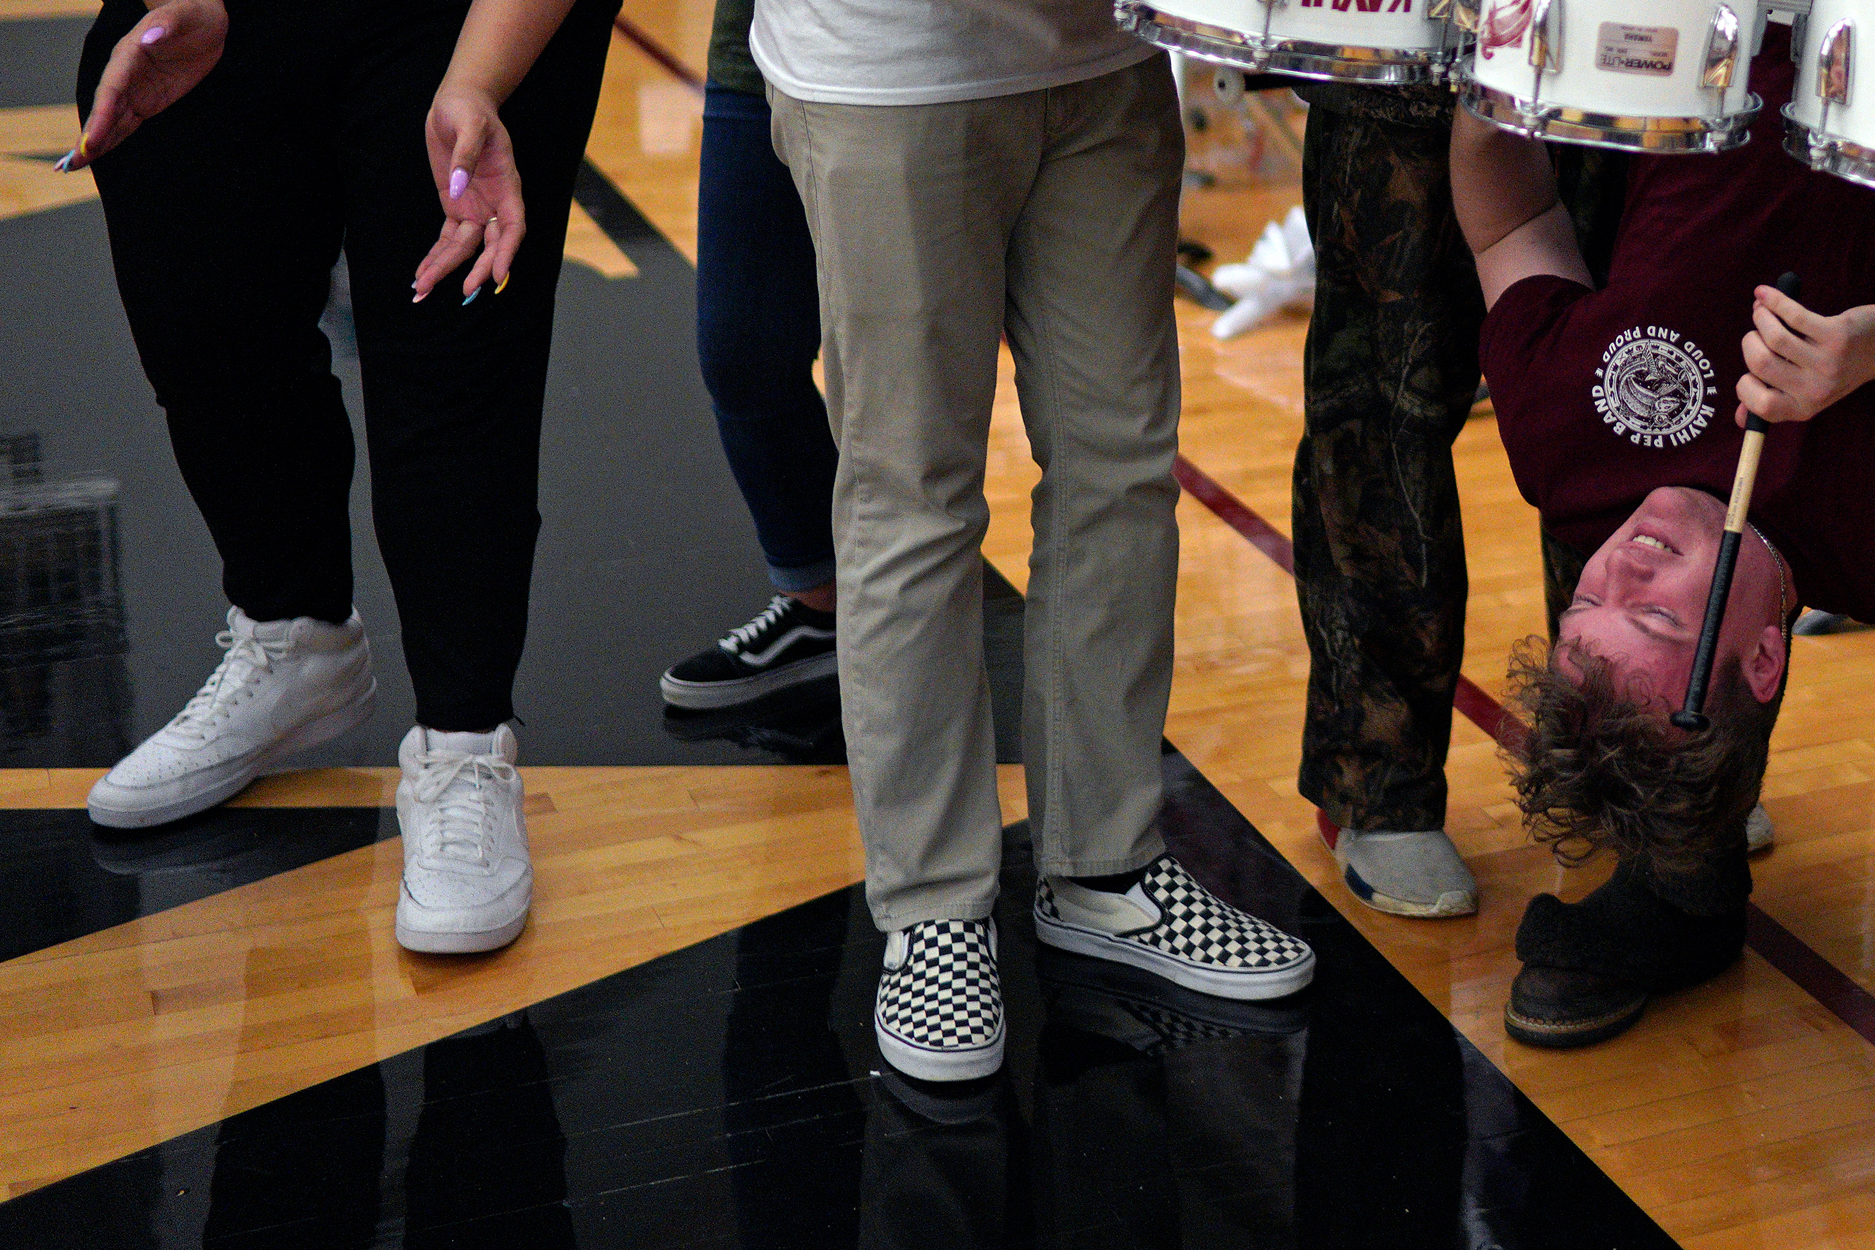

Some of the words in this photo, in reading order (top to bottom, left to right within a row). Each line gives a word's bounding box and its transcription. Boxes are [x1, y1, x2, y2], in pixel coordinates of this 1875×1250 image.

[1602, 325, 1642, 363] PROUD
[1646, 325, 1680, 343] AND
[1684, 341, 1715, 378] LOUD
[1591, 385, 1626, 435] BAND
[1669, 404, 1715, 447] KAYHI
[1630, 433, 1664, 448] PEP
